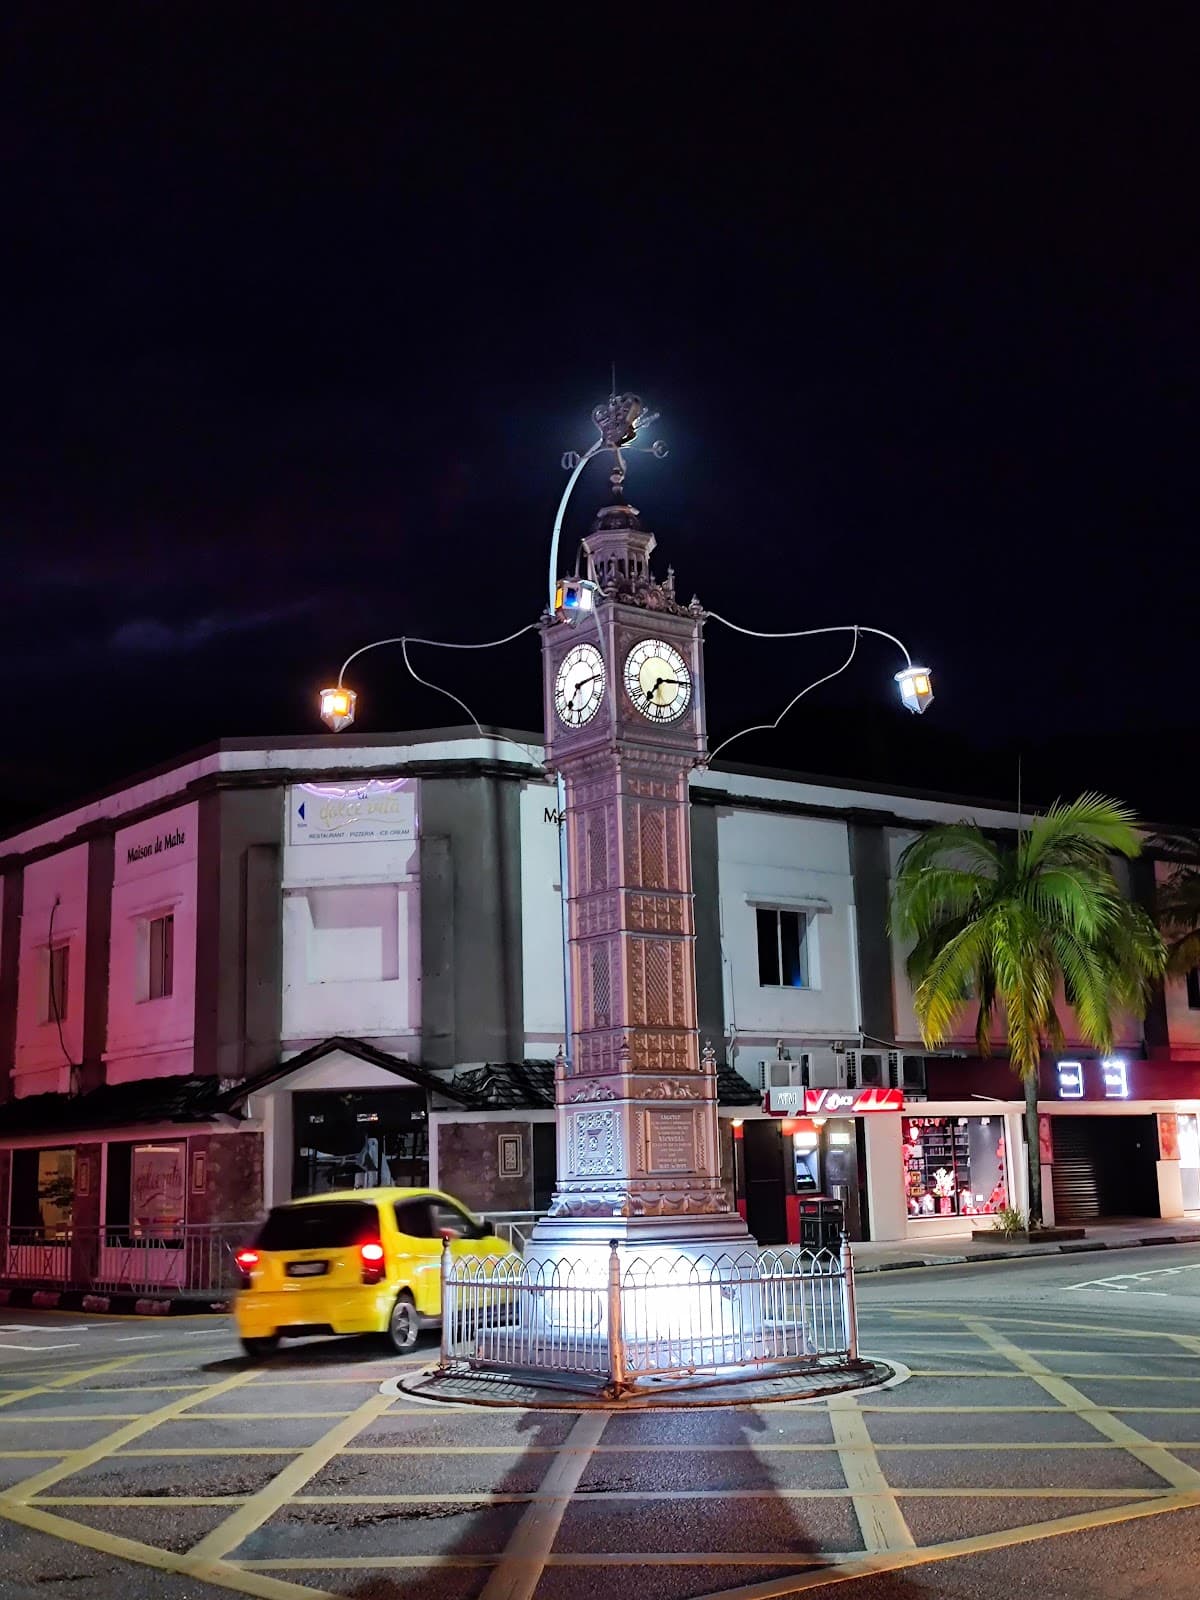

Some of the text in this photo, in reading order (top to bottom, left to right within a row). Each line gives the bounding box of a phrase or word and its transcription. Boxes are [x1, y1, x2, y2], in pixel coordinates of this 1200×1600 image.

[126, 827, 185, 864] Maison de Mahe
[777, 1092, 797, 1105] ATM
